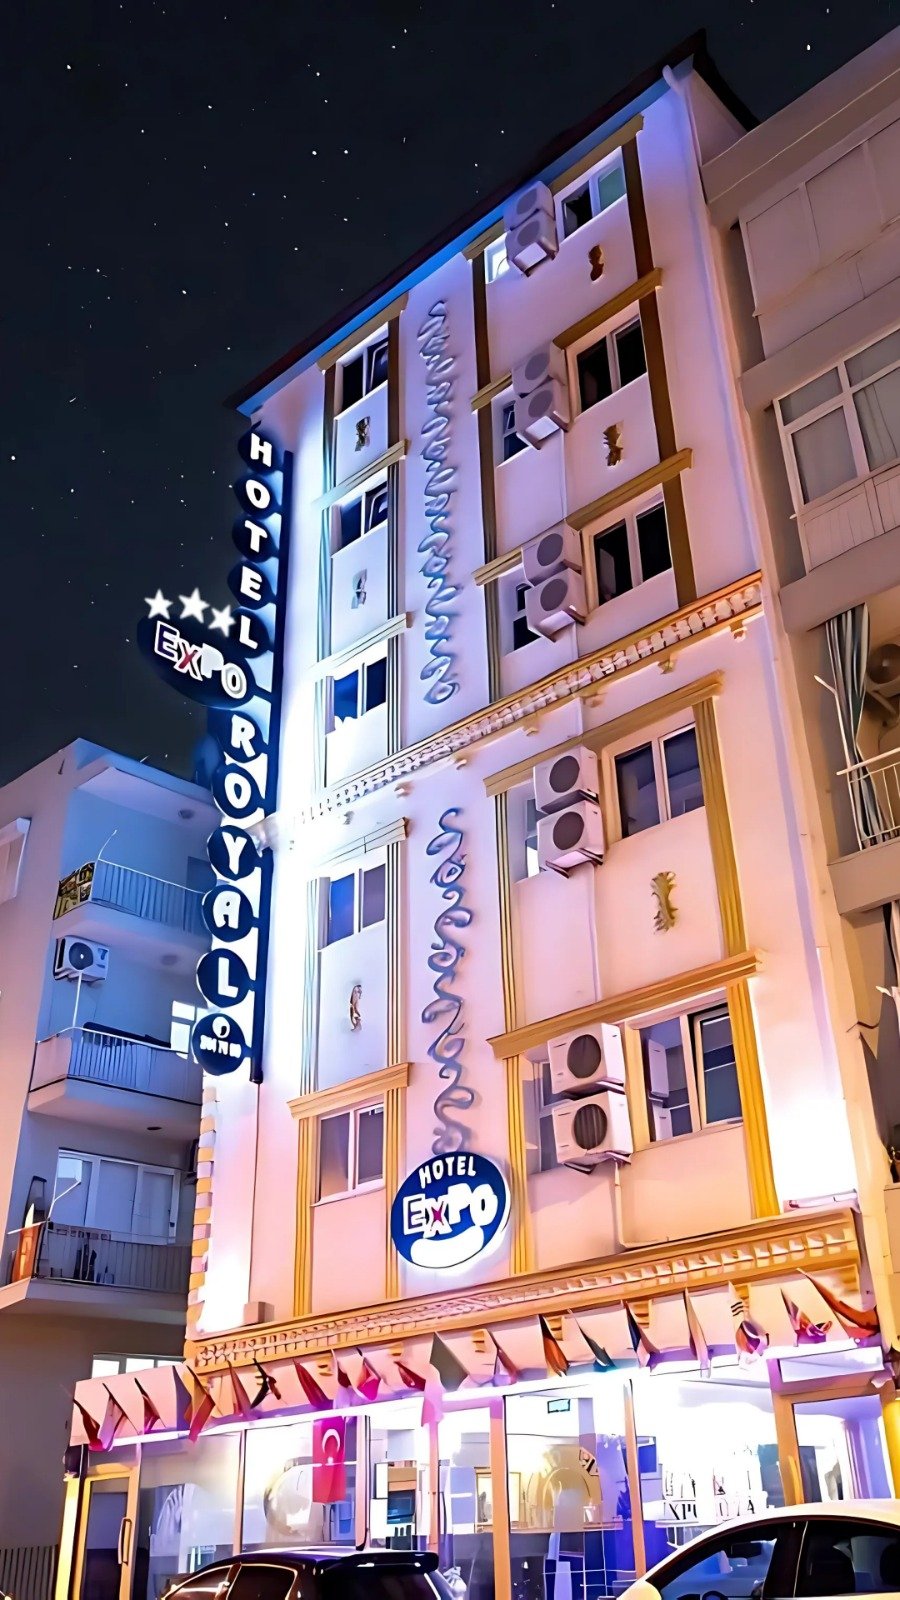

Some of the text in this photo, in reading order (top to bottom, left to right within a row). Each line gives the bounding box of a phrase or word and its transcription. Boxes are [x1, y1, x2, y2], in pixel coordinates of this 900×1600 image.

[239, 433, 272, 650] HOTEL
[154, 620, 247, 699] EXPO
[213, 713, 256, 998] ROYAL
[402, 1182, 499, 1239] EXPO
[418, 1155, 477, 1189] HOTEL
